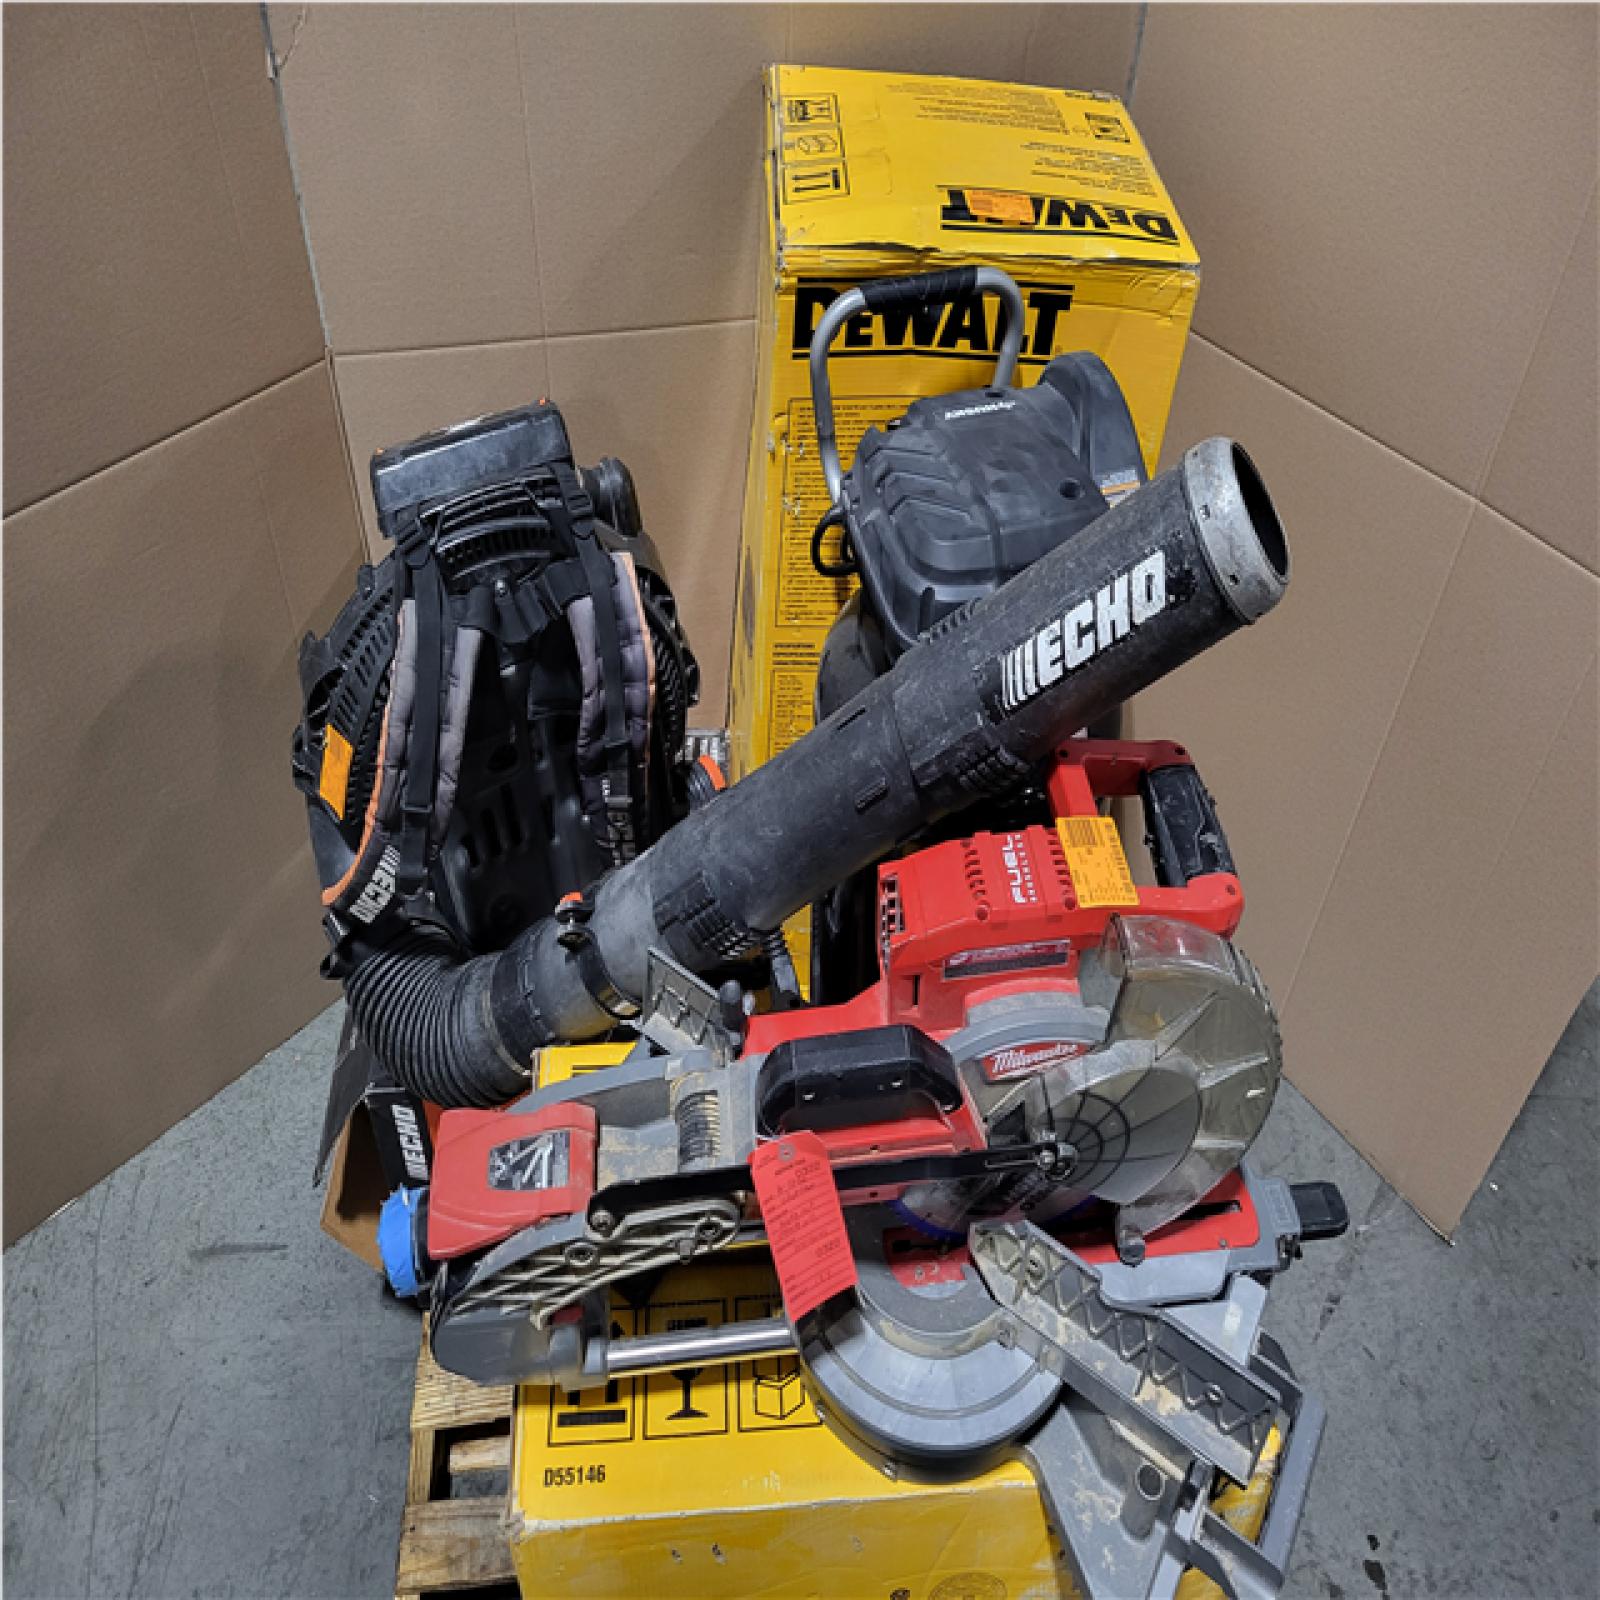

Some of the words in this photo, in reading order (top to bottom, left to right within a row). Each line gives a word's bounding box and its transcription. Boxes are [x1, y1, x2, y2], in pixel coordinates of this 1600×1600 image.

[1037, 550, 1166, 686] ECHO
[1002, 834, 1026, 903] FUEL
[392, 1105, 426, 1165] ECHO
[544, 1464, 606, 1487] D55146
